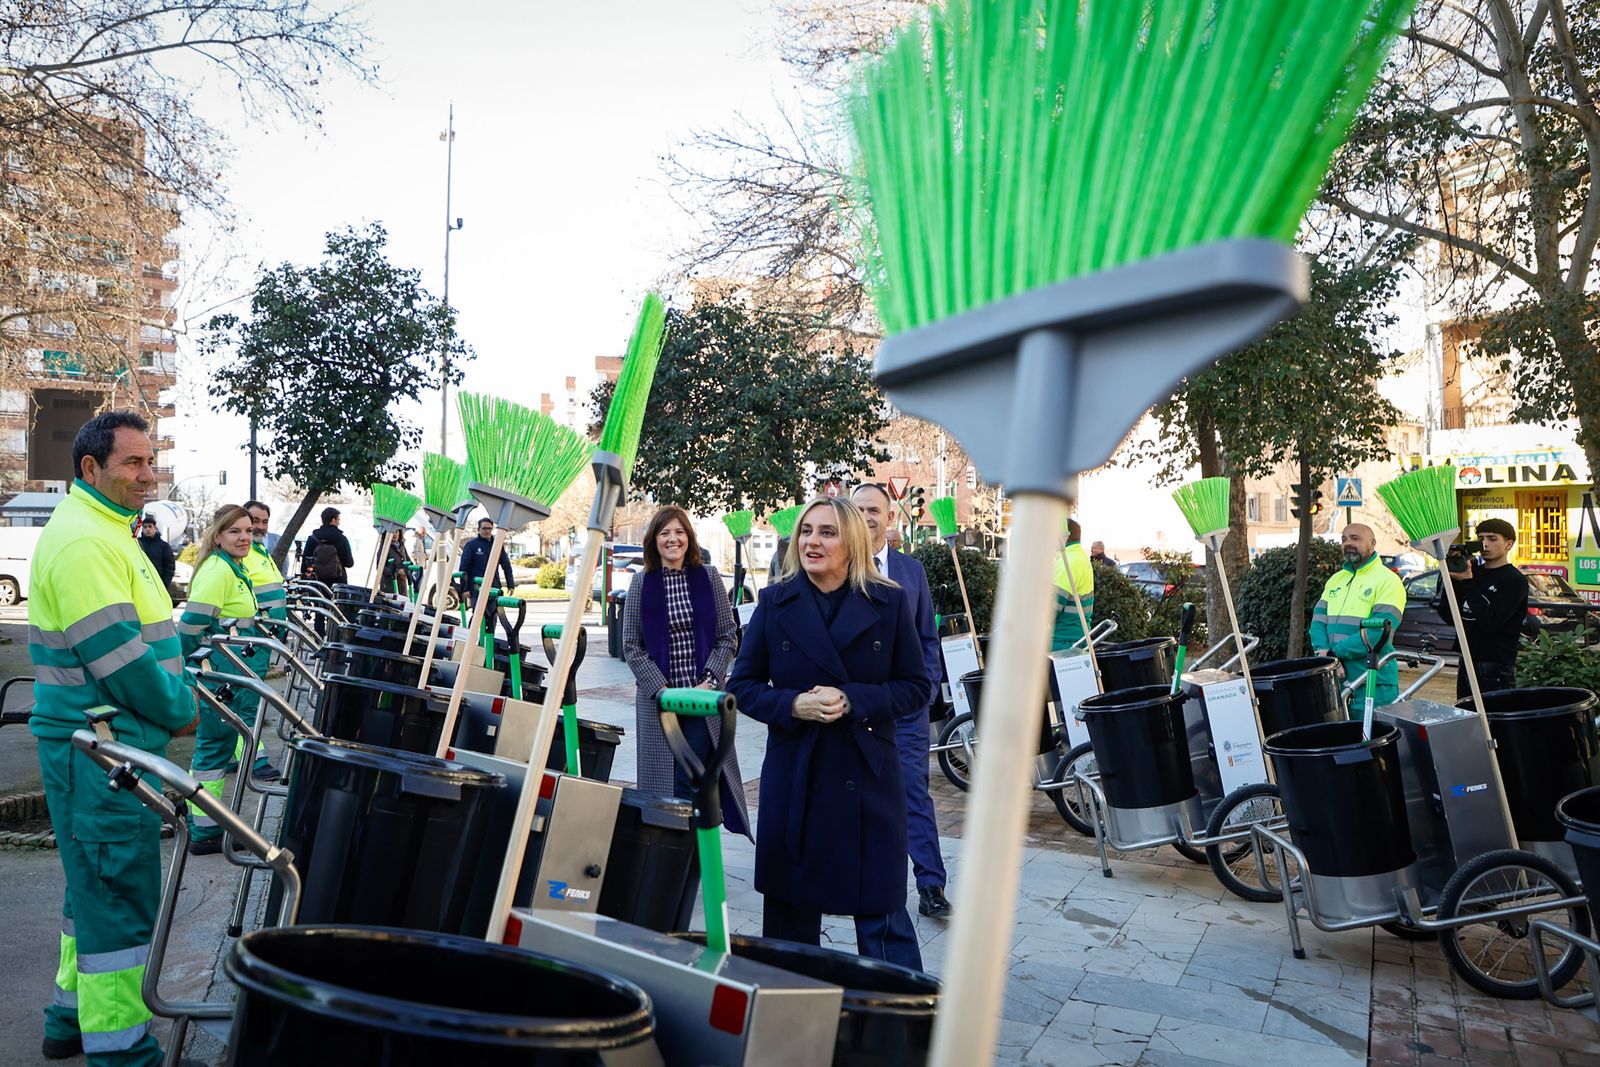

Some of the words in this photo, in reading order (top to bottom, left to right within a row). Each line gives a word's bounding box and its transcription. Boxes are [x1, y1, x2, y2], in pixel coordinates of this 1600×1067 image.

[1459, 464, 1578, 485] OLINA
[1472, 496, 1505, 504] PERMISOS
[1579, 559, 1597, 570] LOS
[1579, 591, 1600, 602] MEJ
[1207, 692, 1238, 702] GRANADA
